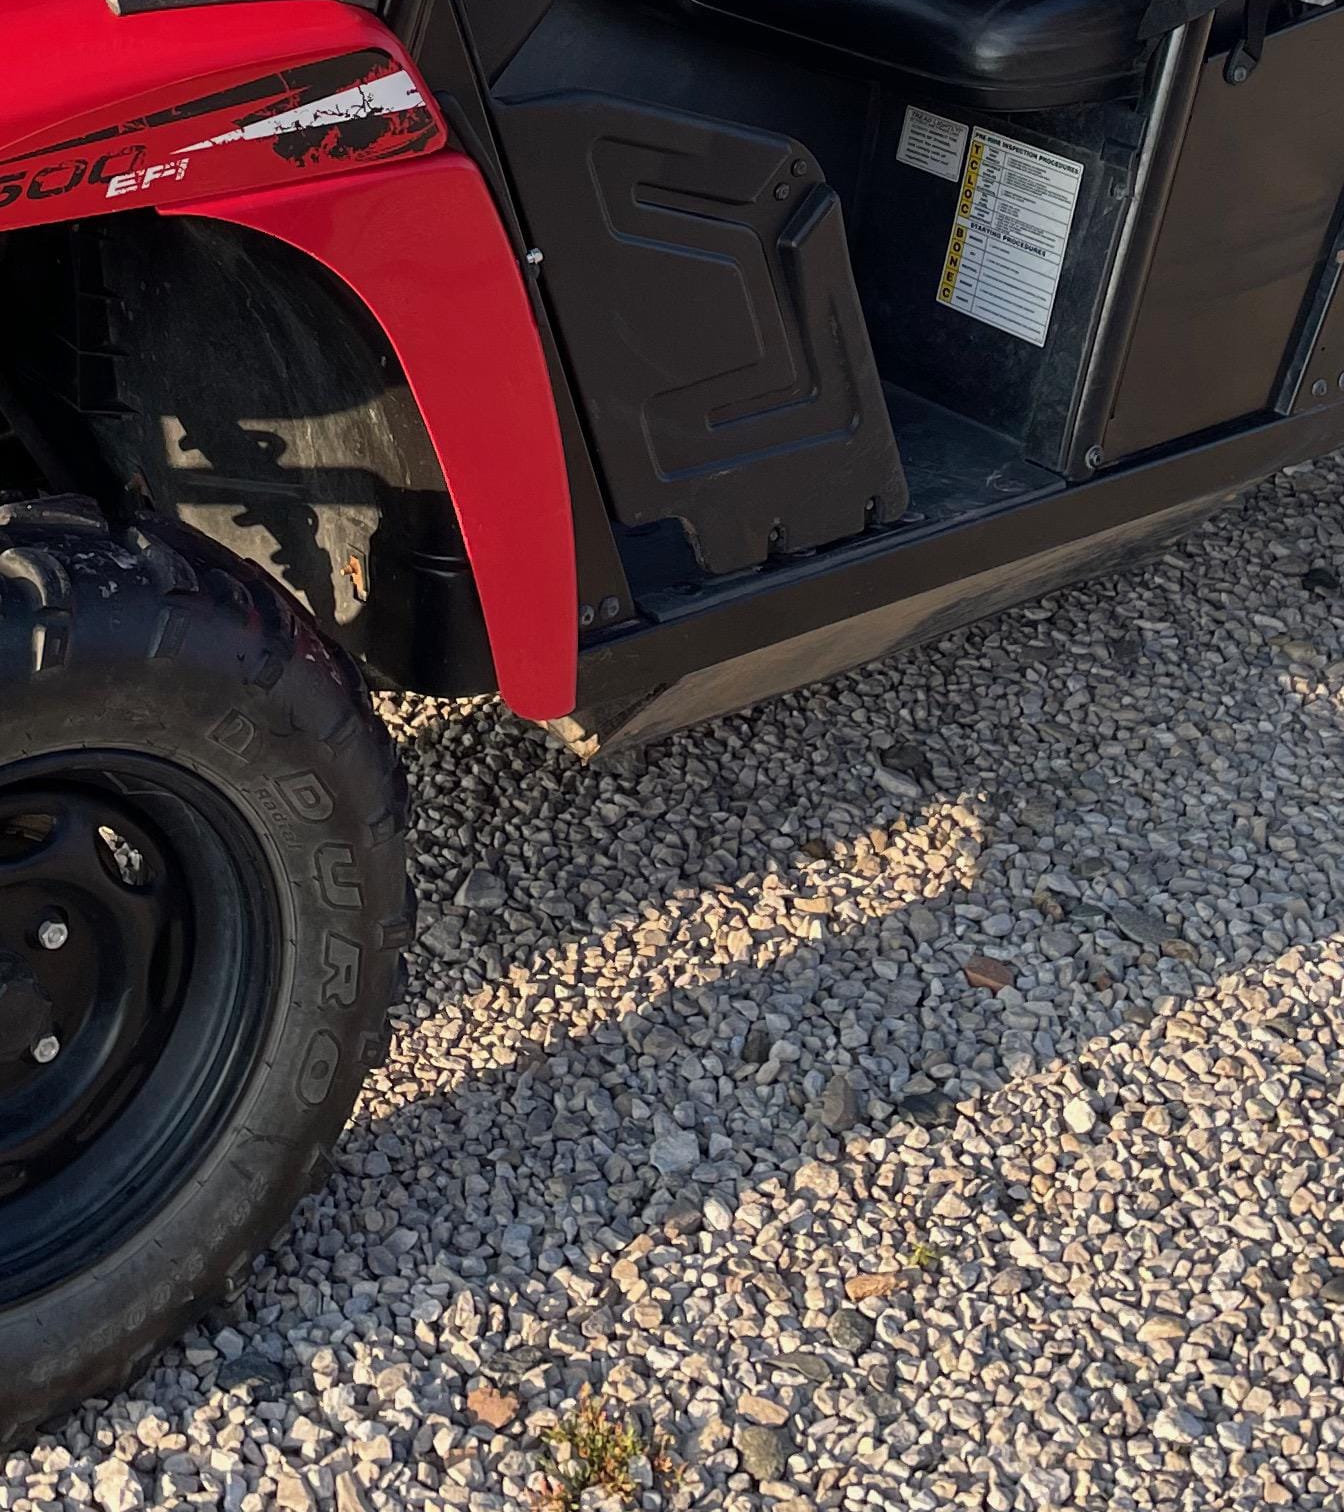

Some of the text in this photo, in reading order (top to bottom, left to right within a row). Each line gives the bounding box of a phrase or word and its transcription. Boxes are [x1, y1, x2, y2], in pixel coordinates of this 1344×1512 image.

[1002, 141, 1038, 160] INSPECTION
[1038, 154, 1080, 175] PROCEDURES
[970, 222, 1002, 240] STARTING
[1002, 235, 1046, 257] PROCEDURES
[253, 786, 304, 852] Radial
[273, 768, 365, 1106] DURO
